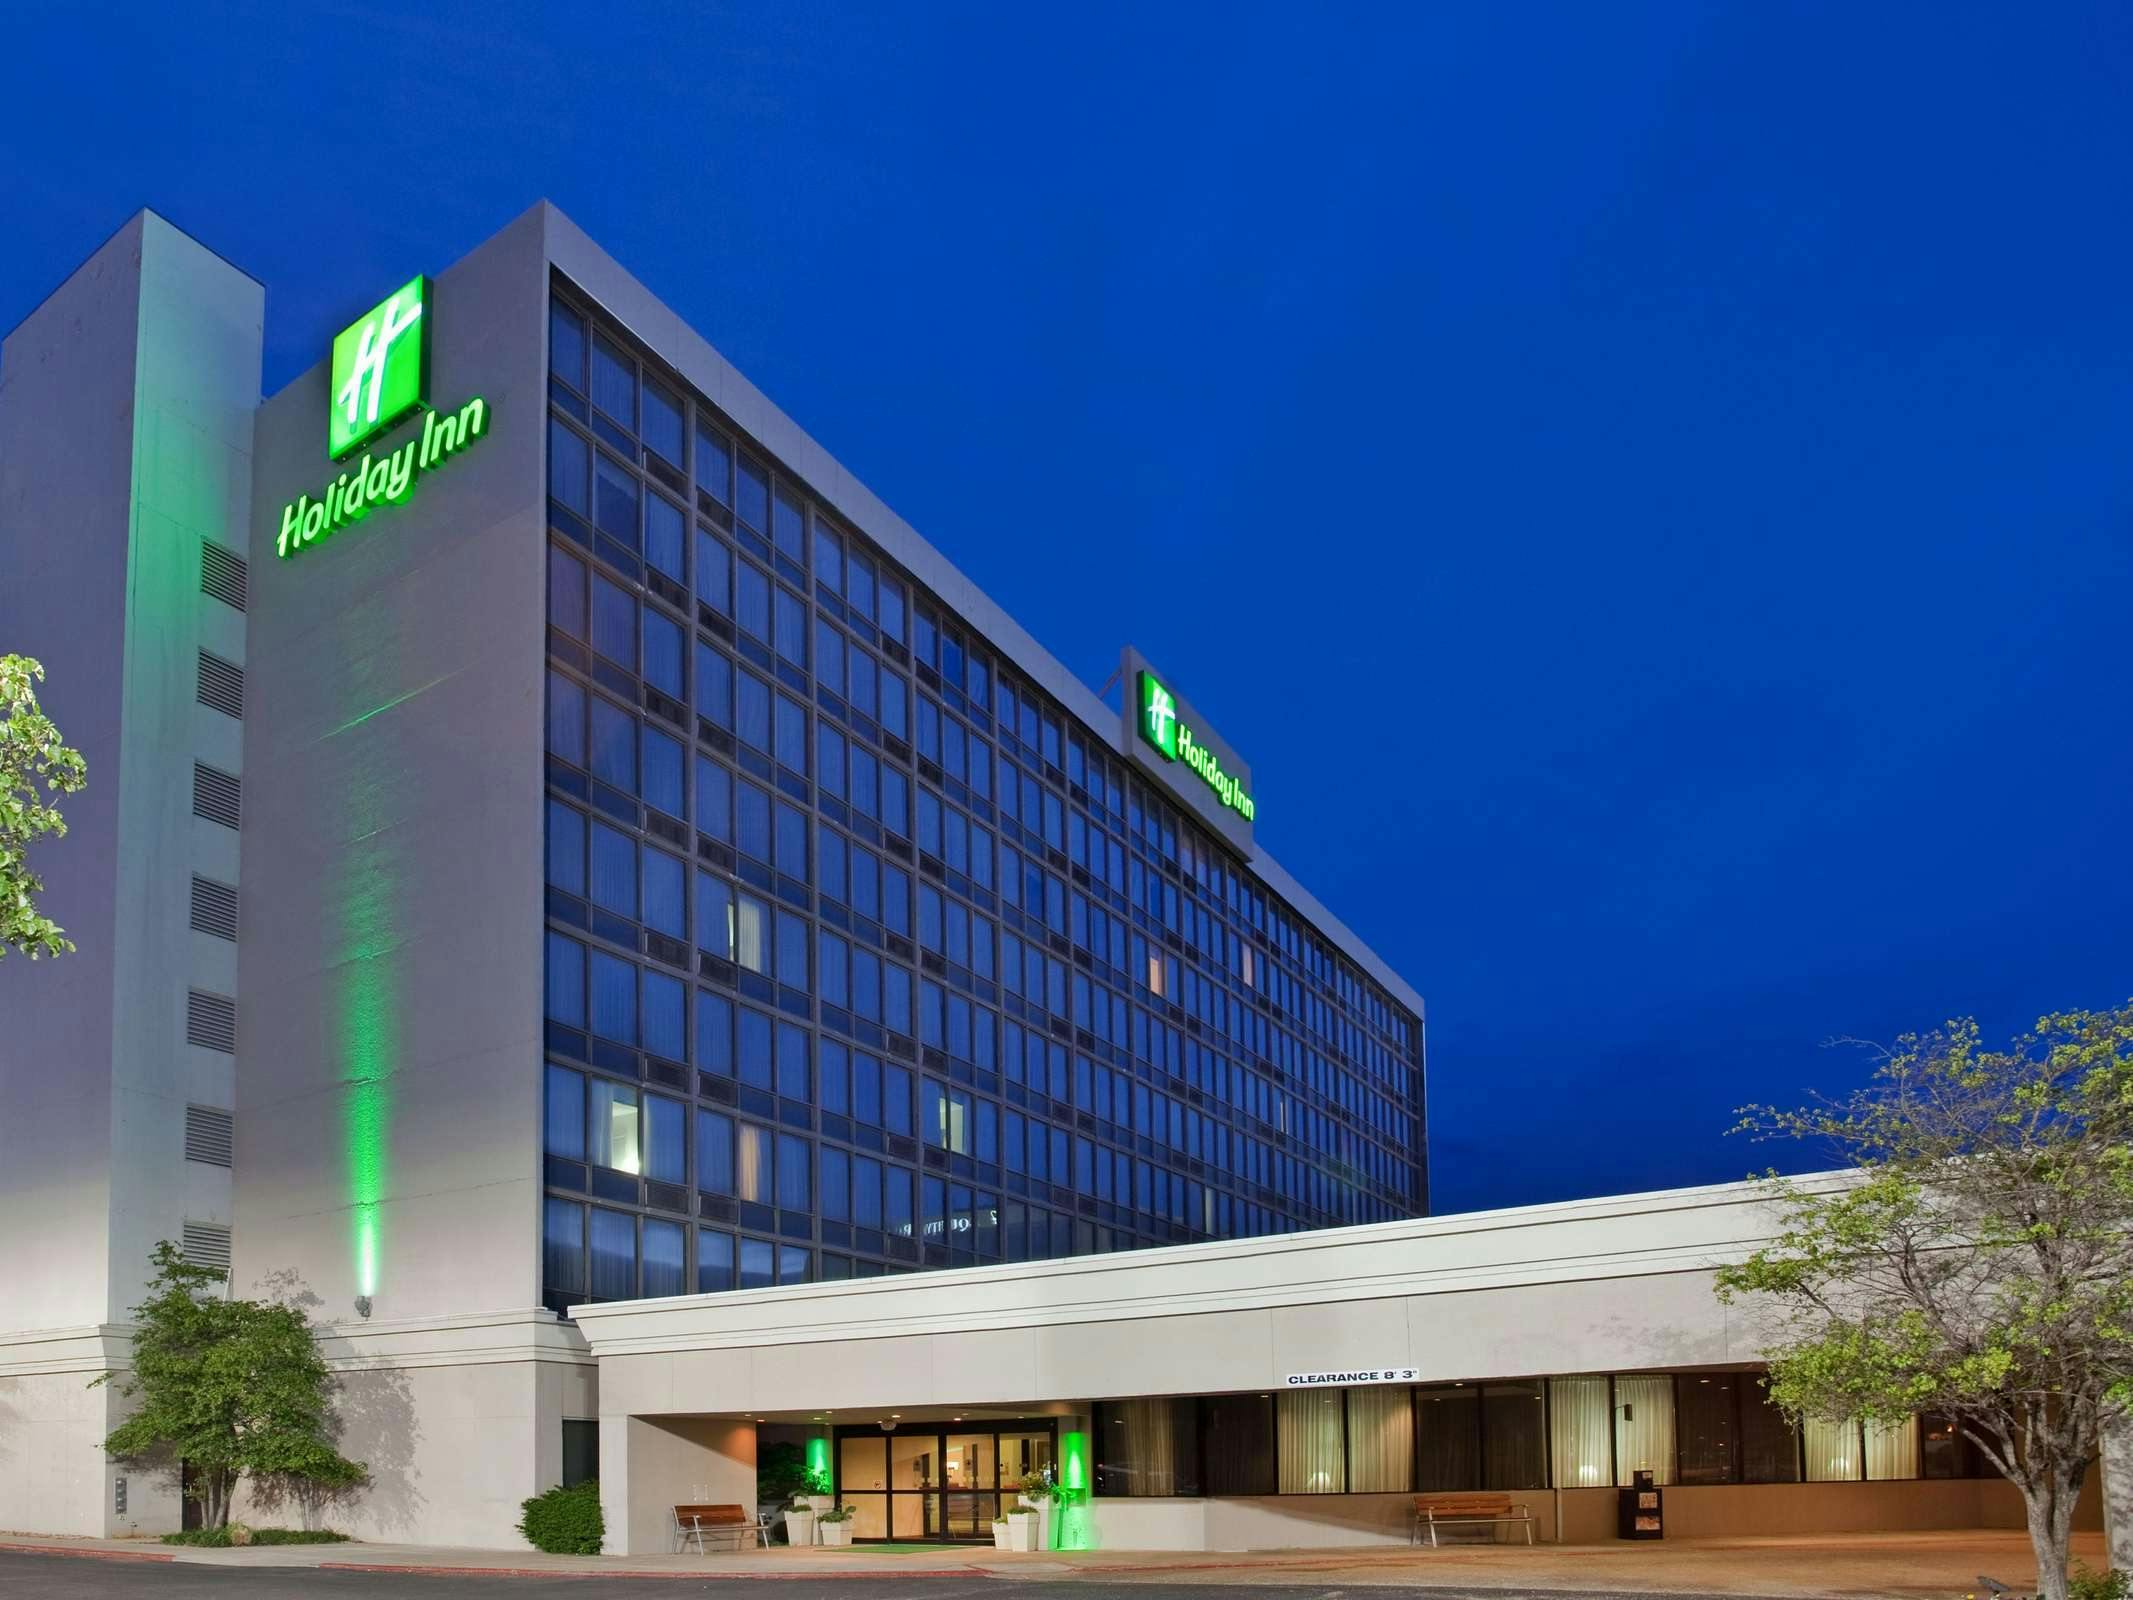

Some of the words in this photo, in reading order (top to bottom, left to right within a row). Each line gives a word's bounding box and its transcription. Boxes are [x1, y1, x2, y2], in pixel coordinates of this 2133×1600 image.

[336, 296, 422, 425] H
[277, 441, 416, 557] Holiday
[419, 398, 487, 469] Inn
[1147, 687, 1176, 744] H
[1178, 724, 1233, 806] Holiday
[1234, 778, 1254, 821] Inn
[1288, 1371, 1379, 1384] CLEARANCE
